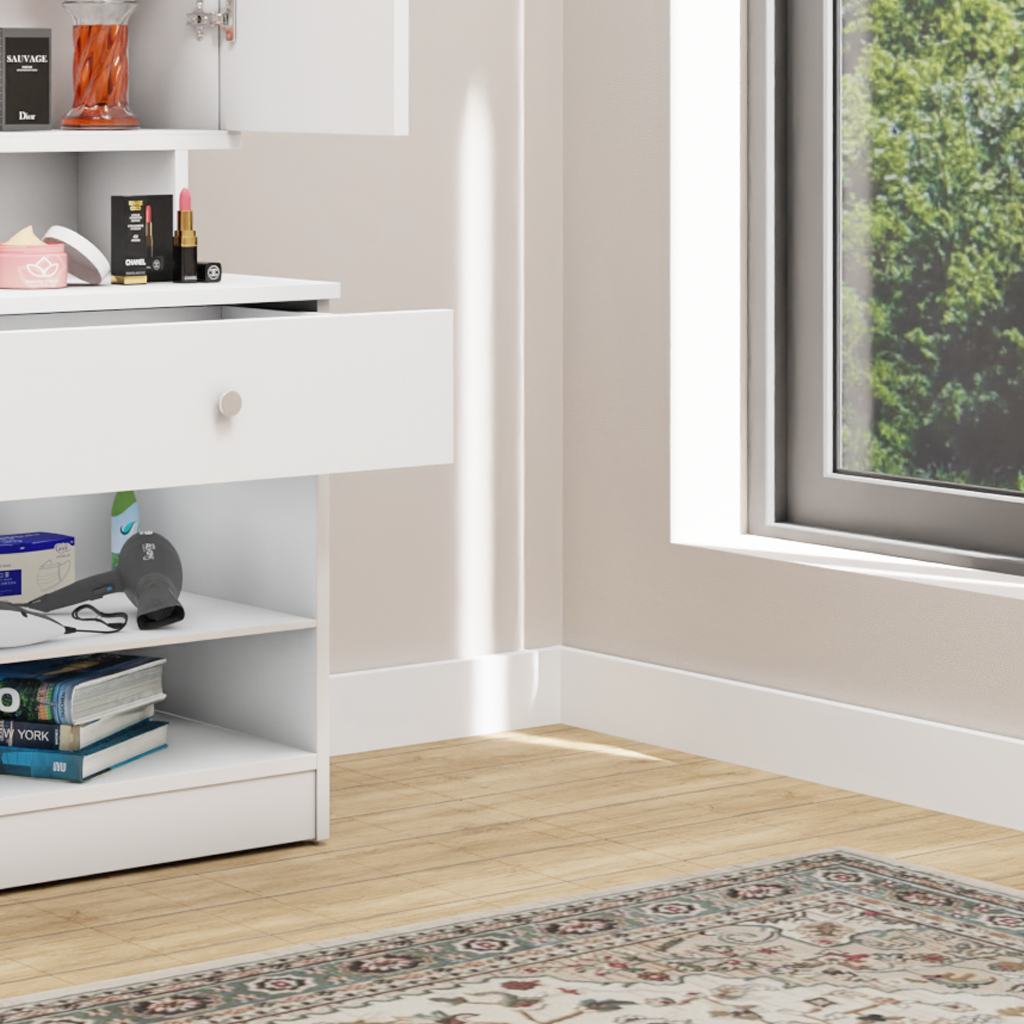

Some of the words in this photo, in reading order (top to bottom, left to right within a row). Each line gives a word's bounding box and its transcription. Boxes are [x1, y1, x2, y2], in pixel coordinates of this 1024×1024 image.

[6, 54, 48, 63] SAUVAGE
[19, 110, 36, 120] Dior
[125, 258, 146, 266] CHANEL
[17, 728, 49, 742] YORK
